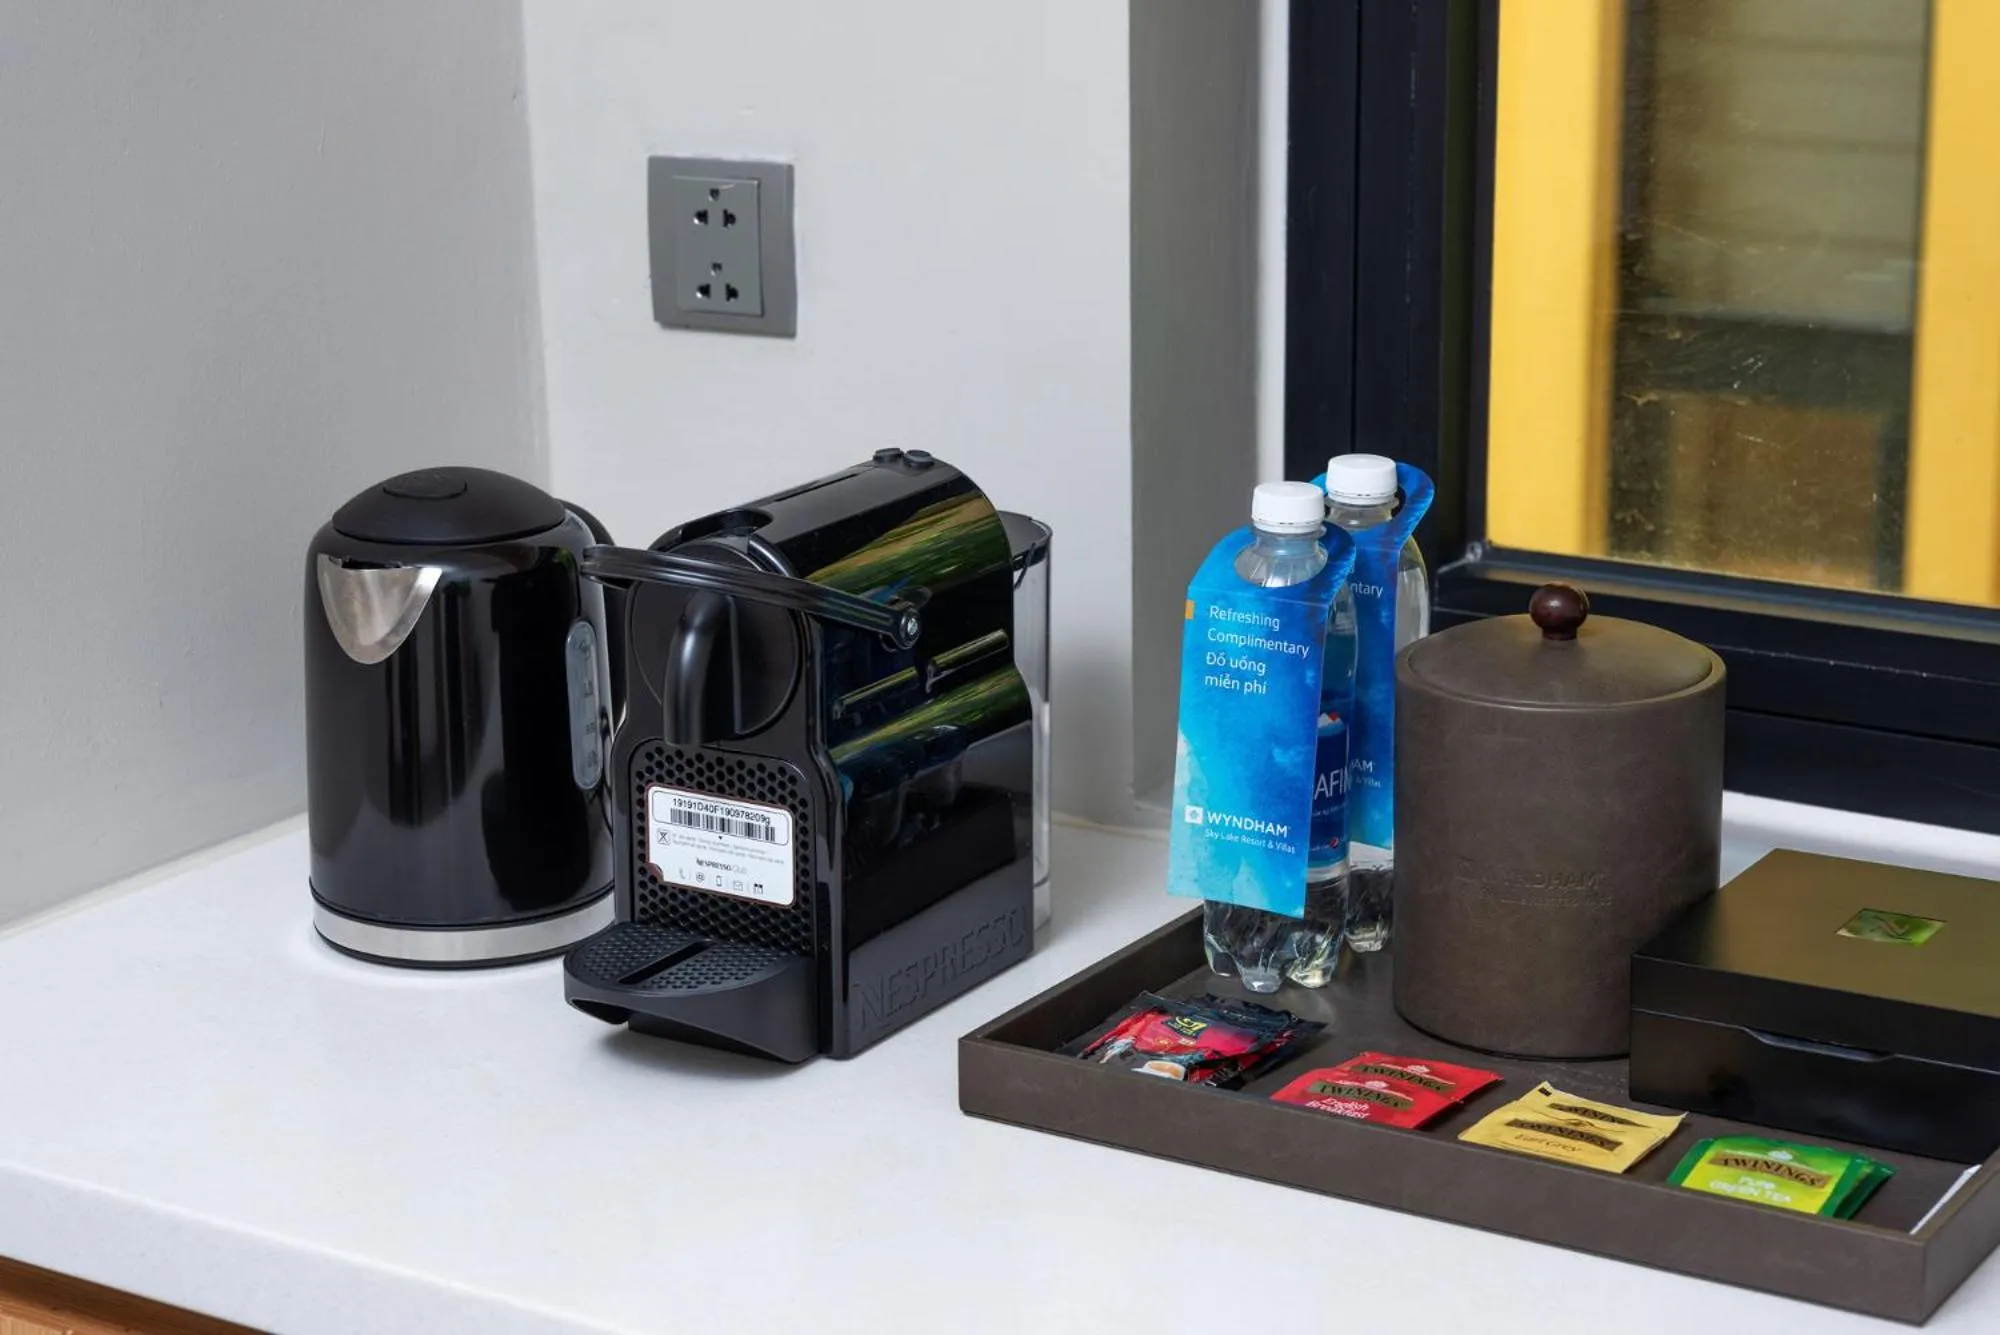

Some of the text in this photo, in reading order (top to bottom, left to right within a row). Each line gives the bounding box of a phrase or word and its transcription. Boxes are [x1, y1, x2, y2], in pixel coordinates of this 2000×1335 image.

[1208, 605, 1280, 632] Refreshing
[1207, 627, 1310, 659] Complimentary
[1206, 810, 1288, 838] WYNDHAM
[1204, 828, 1219, 840] Sky
[1220, 830, 1240, 842] Lake
[1240, 834, 1266, 848] Resort
[1266, 839, 1275, 849] &
[1275, 840, 1296, 854] Villas
[852, 905, 1027, 1032] NESPRESSO
[1361, 1065, 1443, 1091] TWININGS
[1318, 1084, 1401, 1108] TWININGS
[1721, 1157, 1819, 1187] TWININGS
